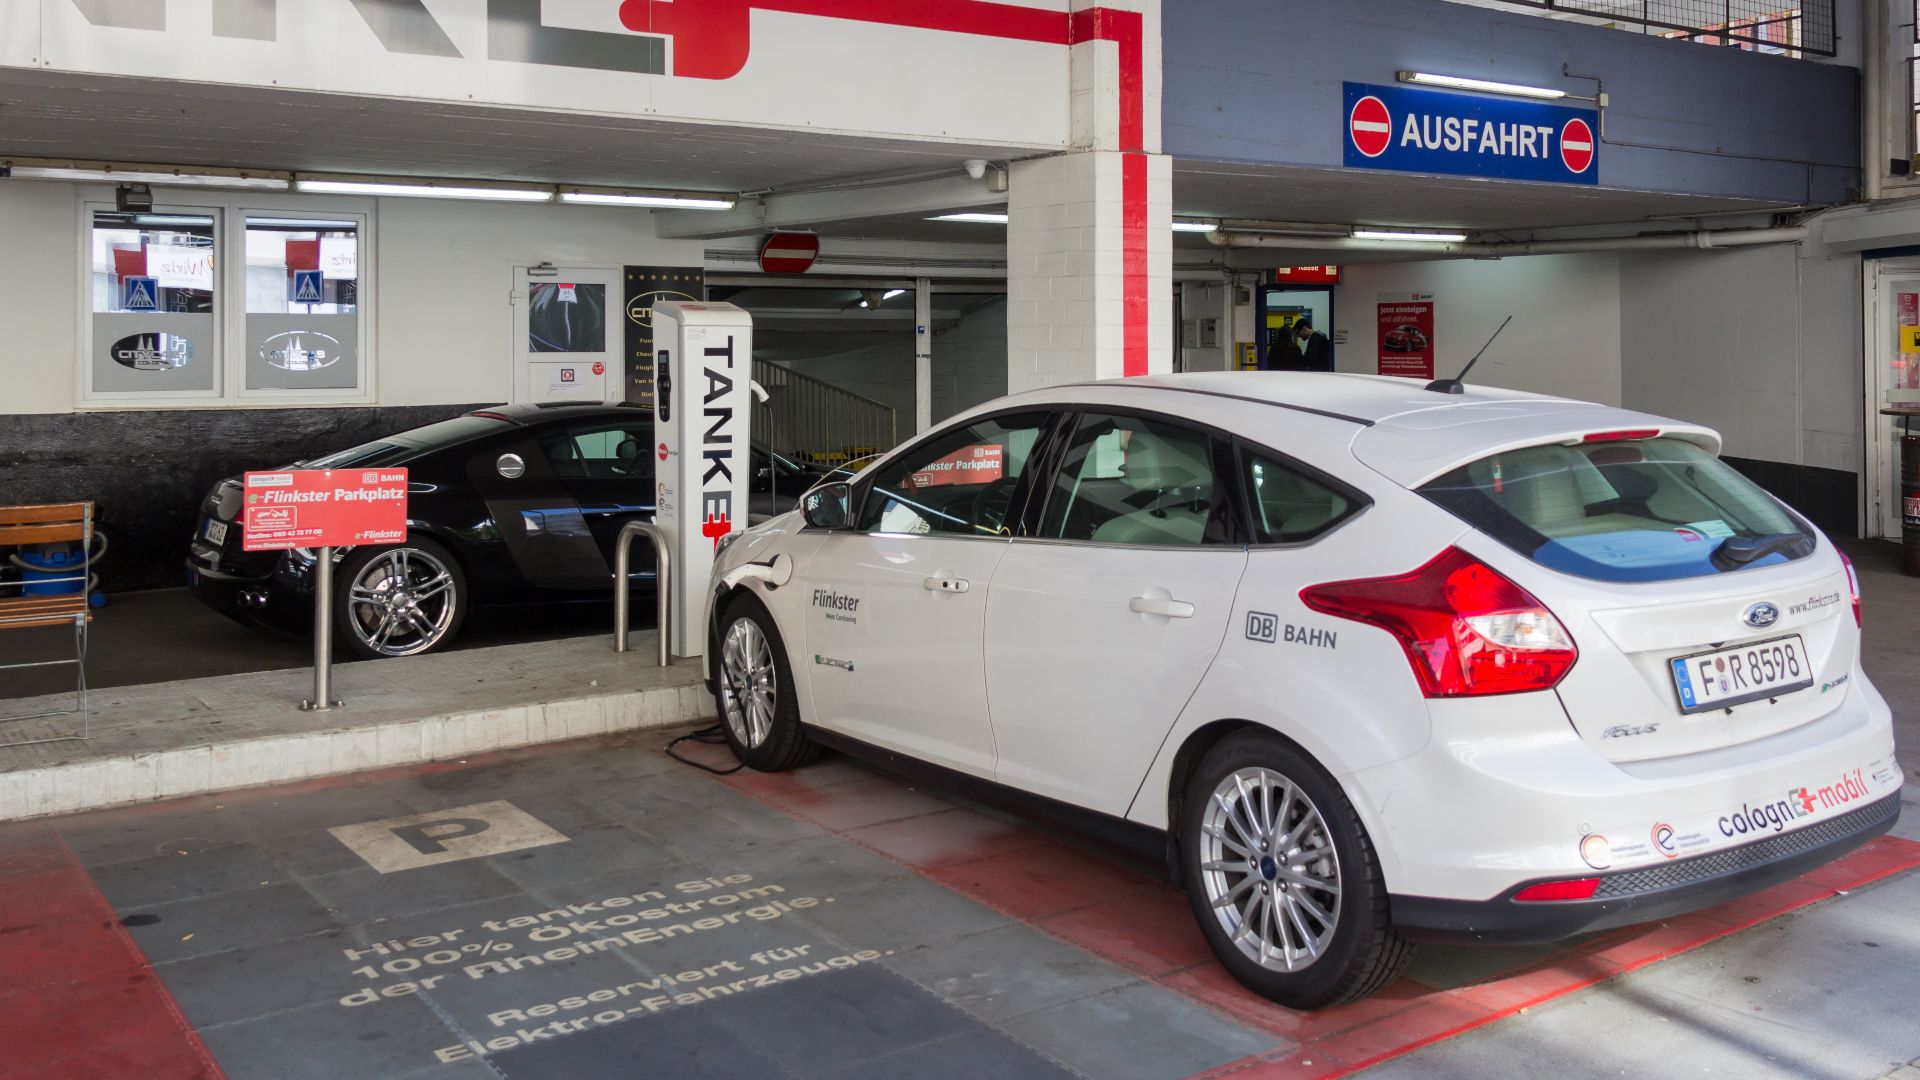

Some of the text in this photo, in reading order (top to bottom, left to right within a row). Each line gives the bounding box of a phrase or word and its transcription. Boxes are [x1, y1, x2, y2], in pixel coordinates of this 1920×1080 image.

[1400, 113, 1554, 159] AUSFAHRT
[1395, 306, 1427, 314] einsteigen
[703, 335, 734, 523] TANKE
[363, 473, 405, 483] DB BAHN
[956, 459, 1000, 471] Parkplatz
[248, 487, 405, 505] e-Flinkster Parkplatz
[247, 532, 273, 540] Hotline:
[813, 588, 860, 612] Flinkster
[1248, 614, 1337, 650] DB BAHN
[1698, 660, 1715, 696] F
[1727, 654, 1748, 689] R
[1749, 643, 1800, 685] 8598
[1683, 687, 1690, 699] D
[389, 817, 490, 855] P
[342, 873, 753, 961] Hier tanken Sie
[352, 883, 785, 979] 100% Ökostrom
[340, 896, 836, 1007] der RheinEnergie.
[487, 944, 811, 1028] Reserviert für
[433, 949, 896, 1064] Elektro-Fahrzeuge.
